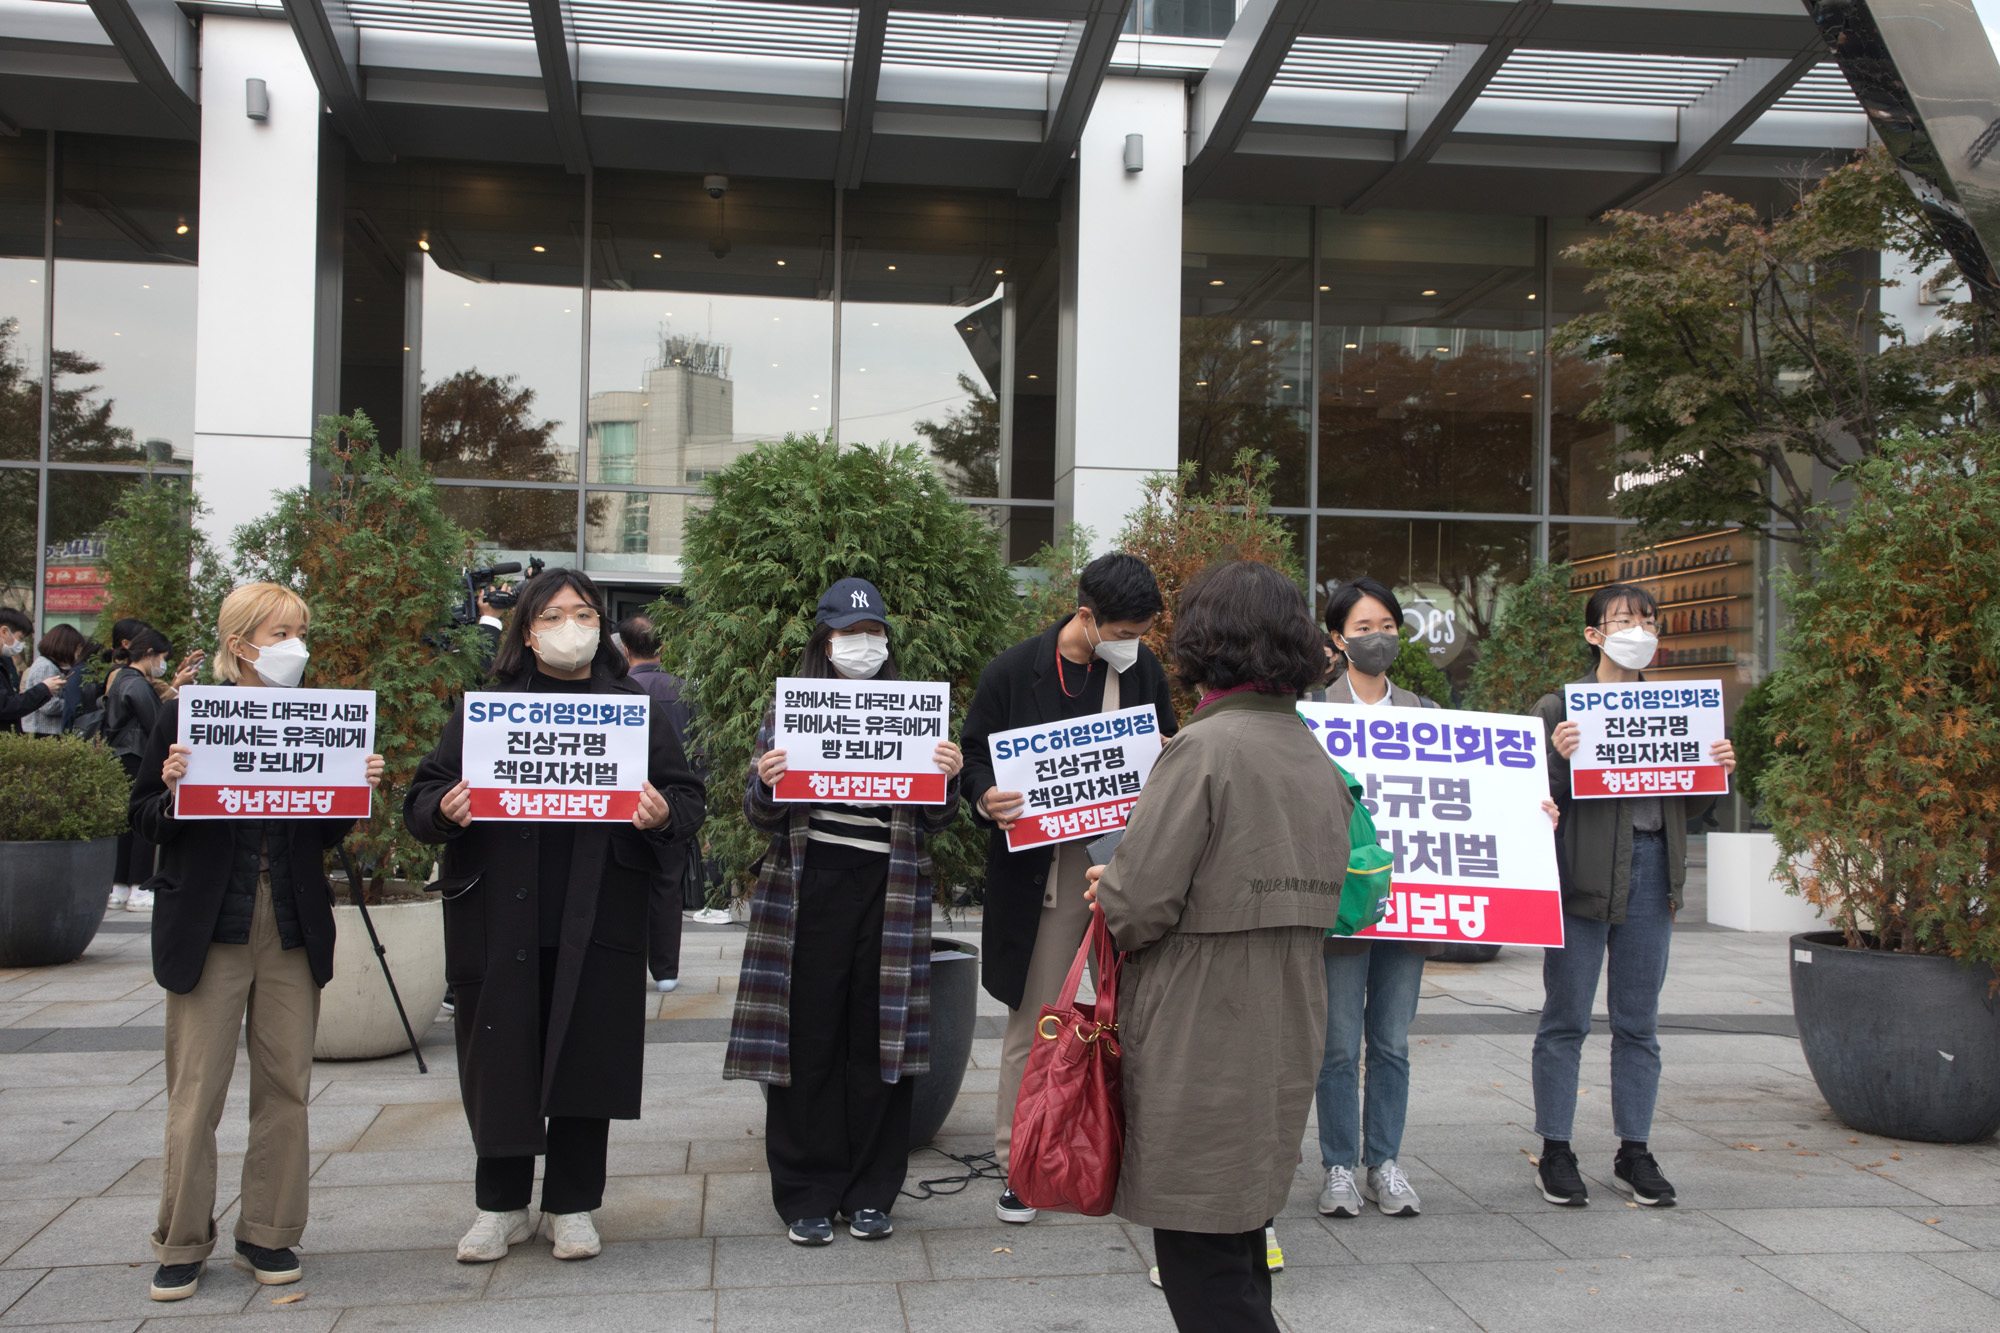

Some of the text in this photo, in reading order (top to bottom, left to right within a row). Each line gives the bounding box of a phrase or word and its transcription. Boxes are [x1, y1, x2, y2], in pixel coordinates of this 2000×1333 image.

[850, 590, 870, 608] NY
[191, 699, 368, 722] 앞에서는 대국민 사과
[784, 691, 943, 712] 앞에서는 대국민 사과
[189, 724, 366, 748] 뒤에서는 유족에게
[784, 713, 941, 737] 뒤에서는 유족에게
[1605, 715, 1688, 738] 진상규명
[507, 731, 607, 756] 진상규명
[822, 740, 902, 760] 빵 보내기
[1305, 717, 1536, 769] 허영인회장
[1596, 741, 1700, 764] 책임자처벌
[233, 752, 324, 773] 빵 보내기
[494, 760, 618, 786] 책임자처벌
[1034, 746, 1126, 783] 진상규명
[809, 773, 914, 799] 청년진보당
[1028, 770, 1142, 809] 책임자처벌
[1602, 770, 1696, 793] 청년진보당
[217, 787, 335, 814] 청년진보당
[499, 790, 611, 817] 청년진보당
